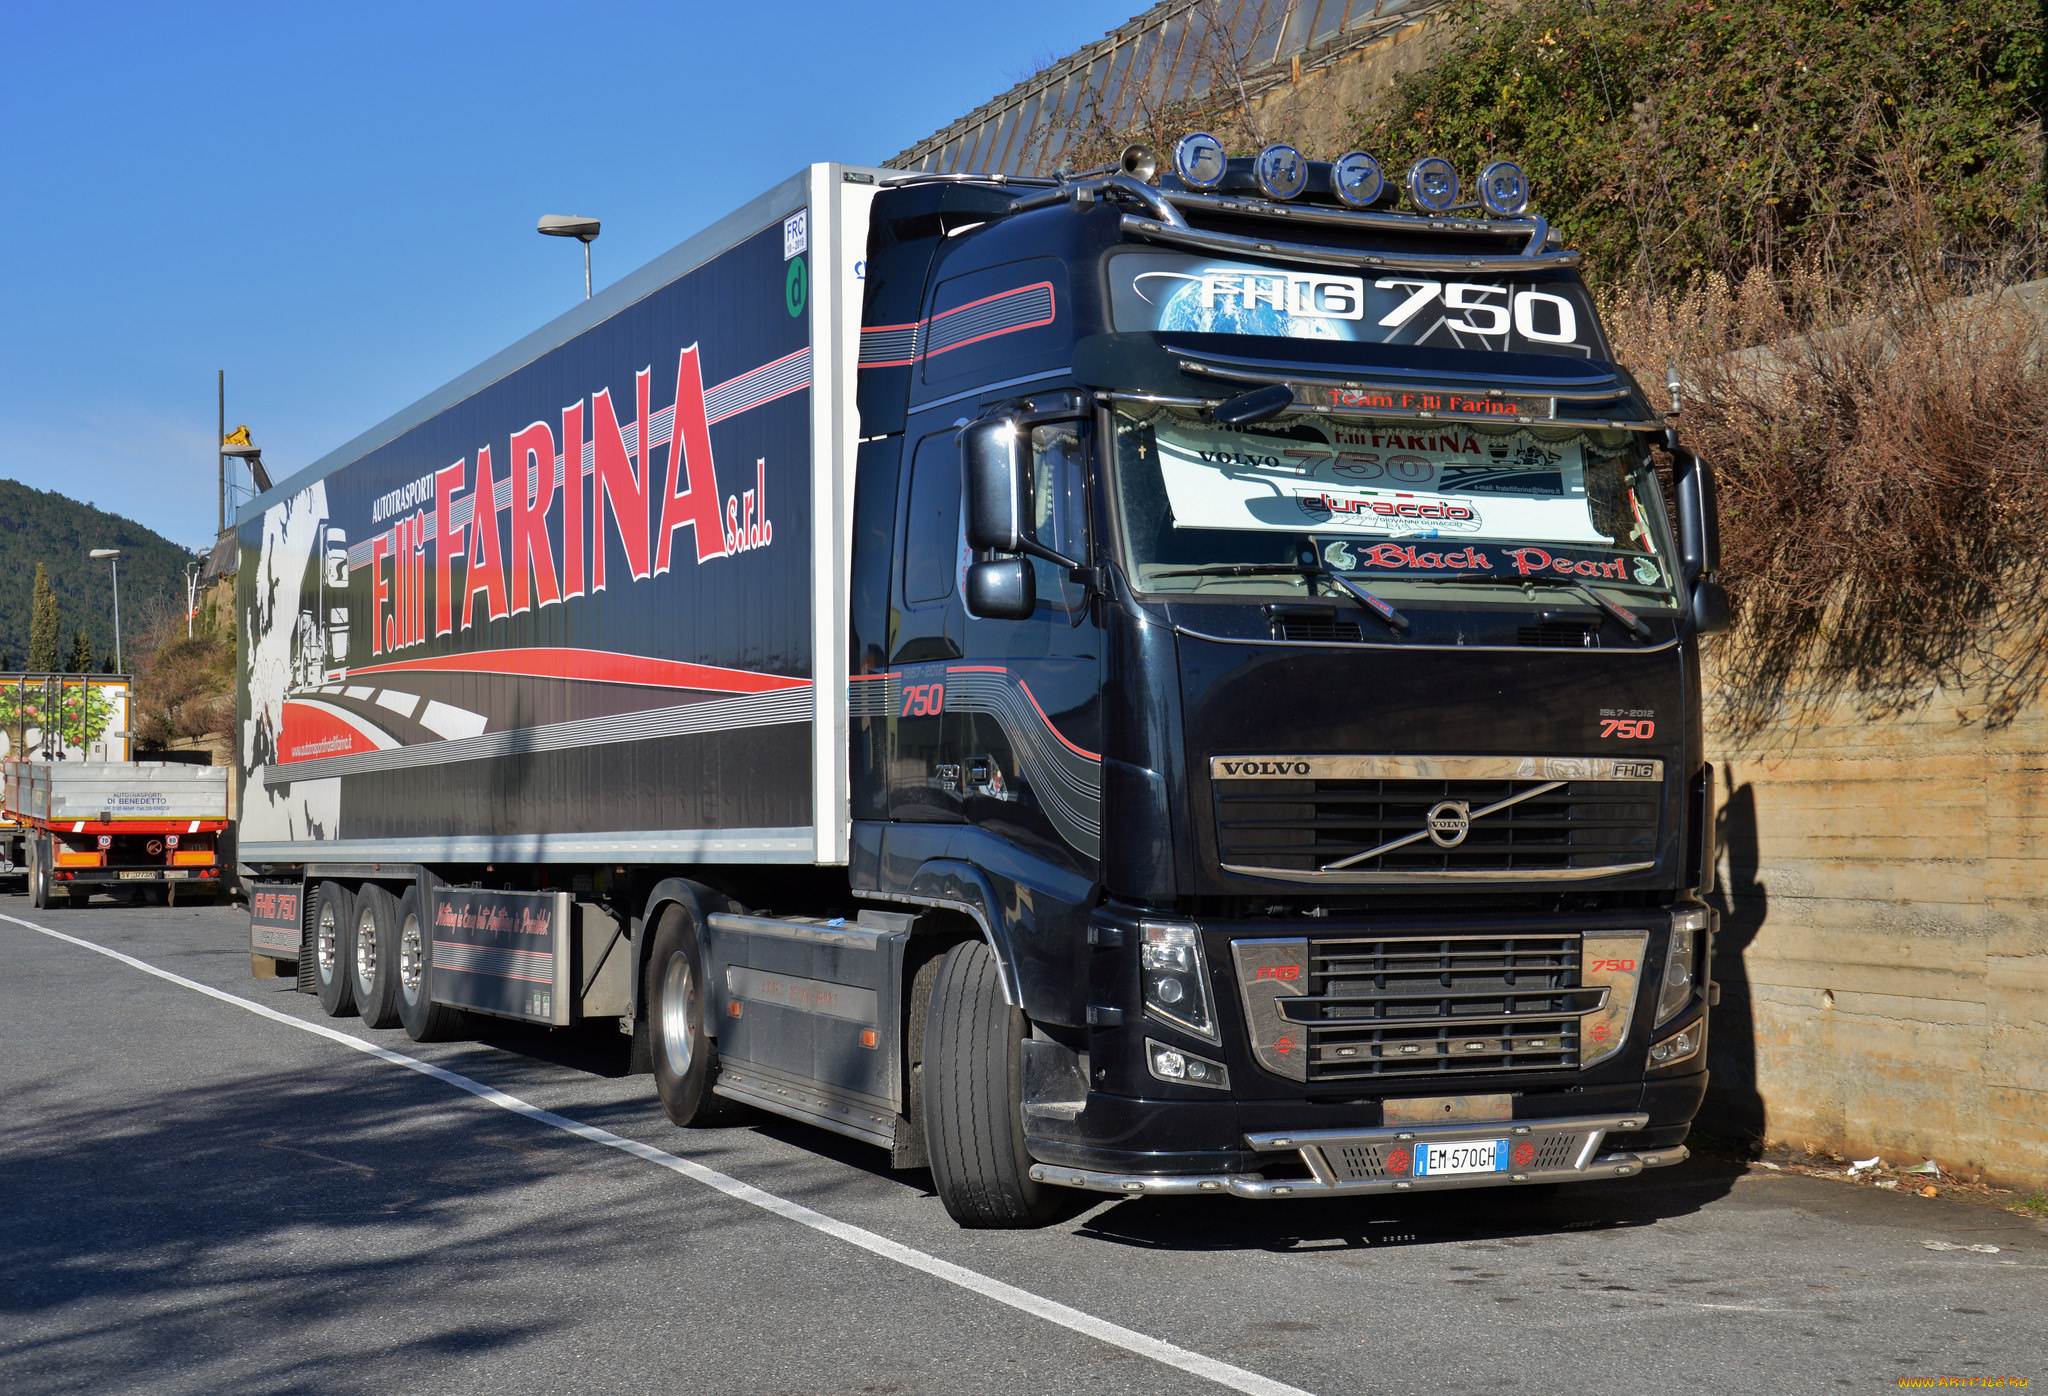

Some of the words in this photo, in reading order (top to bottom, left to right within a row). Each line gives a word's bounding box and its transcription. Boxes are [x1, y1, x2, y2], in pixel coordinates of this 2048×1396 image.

[787, 216, 804, 242] FRC
[1200, 268, 1364, 321] FH16
[1374, 277, 1578, 344] 750
[1328, 390, 1393, 408] Team
[1402, 394, 1441, 411] F.lli
[1450, 397, 1517, 415] Farina
[1198, 450, 1280, 468] VOLVO
[1283, 449, 1434, 483] 750
[372, 472, 434, 525] AUTOTRASPORTI
[435, 340, 729, 639] FARINA
[726, 456, 772, 556] s.r.l.
[1303, 492, 1474, 520] duraccio
[1358, 543, 1493, 569] Black
[1502, 548, 1628, 580] Pearl
[902, 683, 944, 718] 750
[1600, 708, 1655, 718] 1967-2012
[1600, 719, 1655, 739] 750
[1221, 762, 1311, 776] VOLVO
[1613, 762, 1655, 778] FH16
[118, 797, 167, 805] BENEDETTO
[1430, 820, 1468, 828] VOLVO
[276, 894, 297, 921] 750
[1591, 959, 1636, 973] 750
[1429, 1149, 1447, 1170] EM
[1451, 1146, 1496, 1168] 570GH
